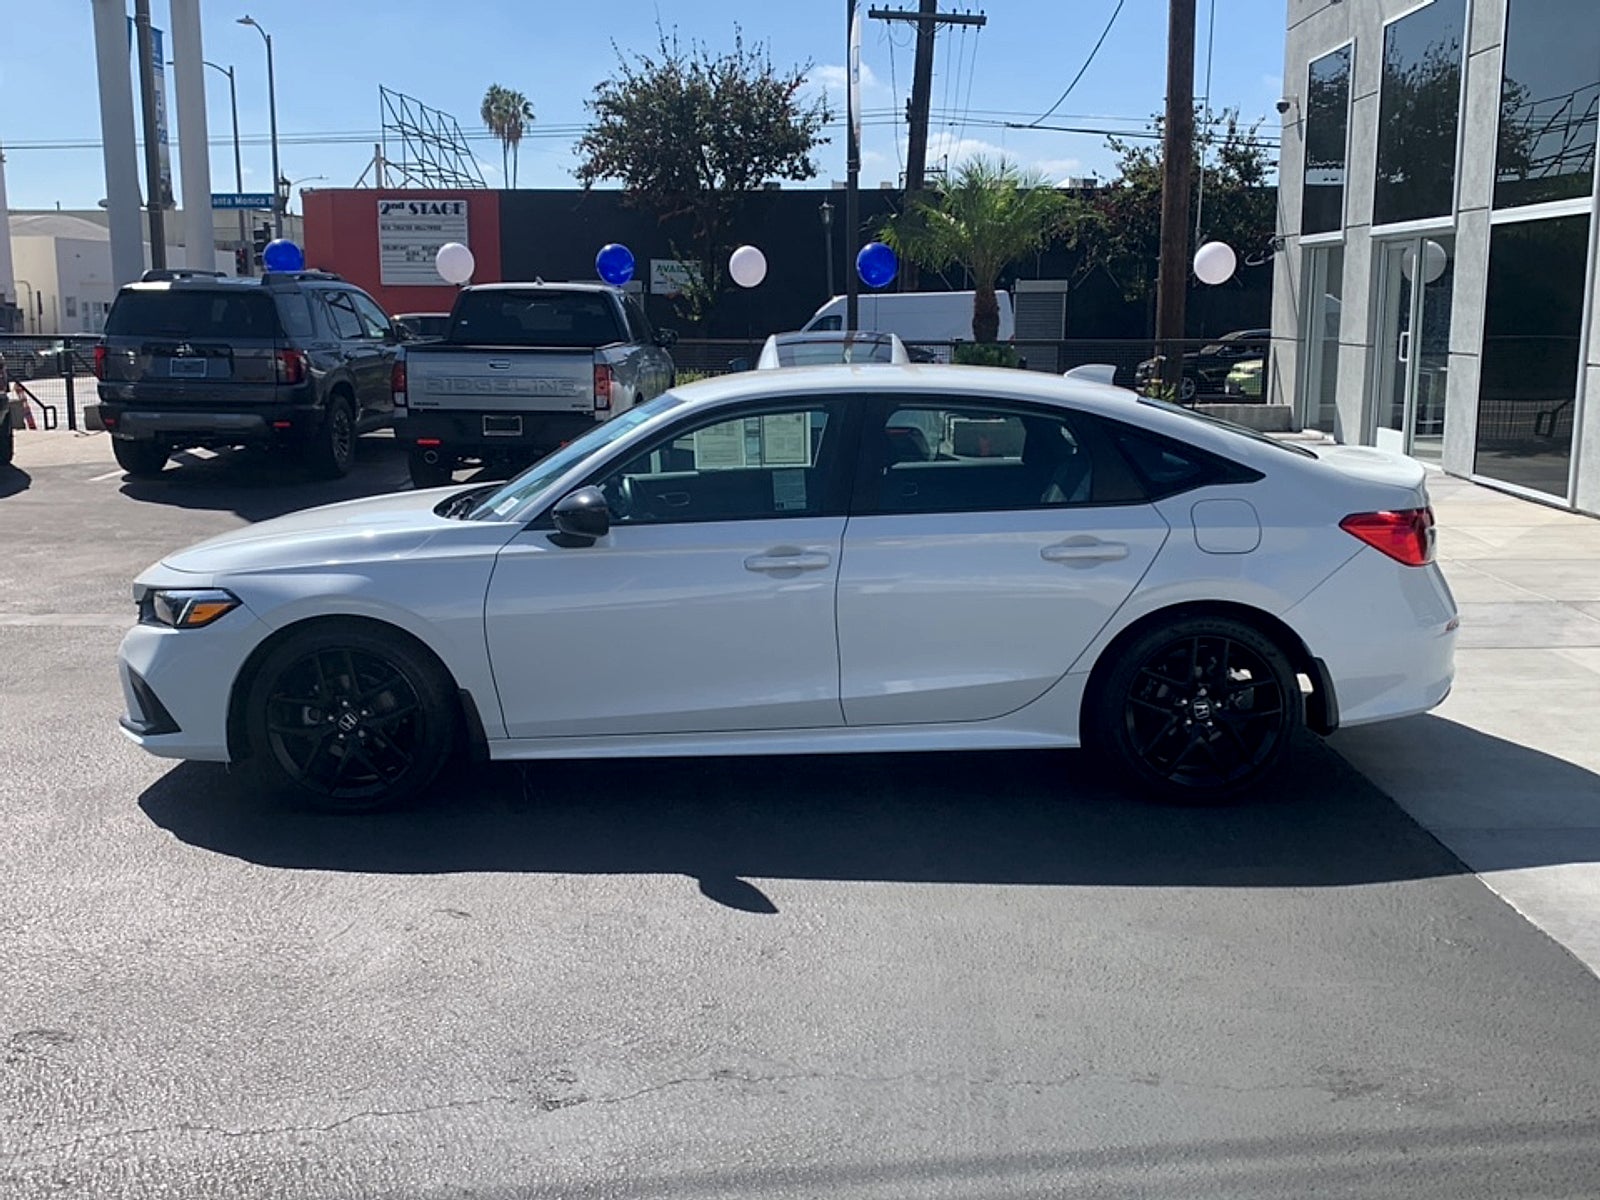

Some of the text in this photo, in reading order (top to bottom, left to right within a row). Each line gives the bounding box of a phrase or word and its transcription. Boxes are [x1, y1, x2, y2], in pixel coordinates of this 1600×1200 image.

[212, 196, 232, 206] anta
[380, 202, 465, 215] 2nd STAGE
[426, 377, 576, 394] RIDGELINE
